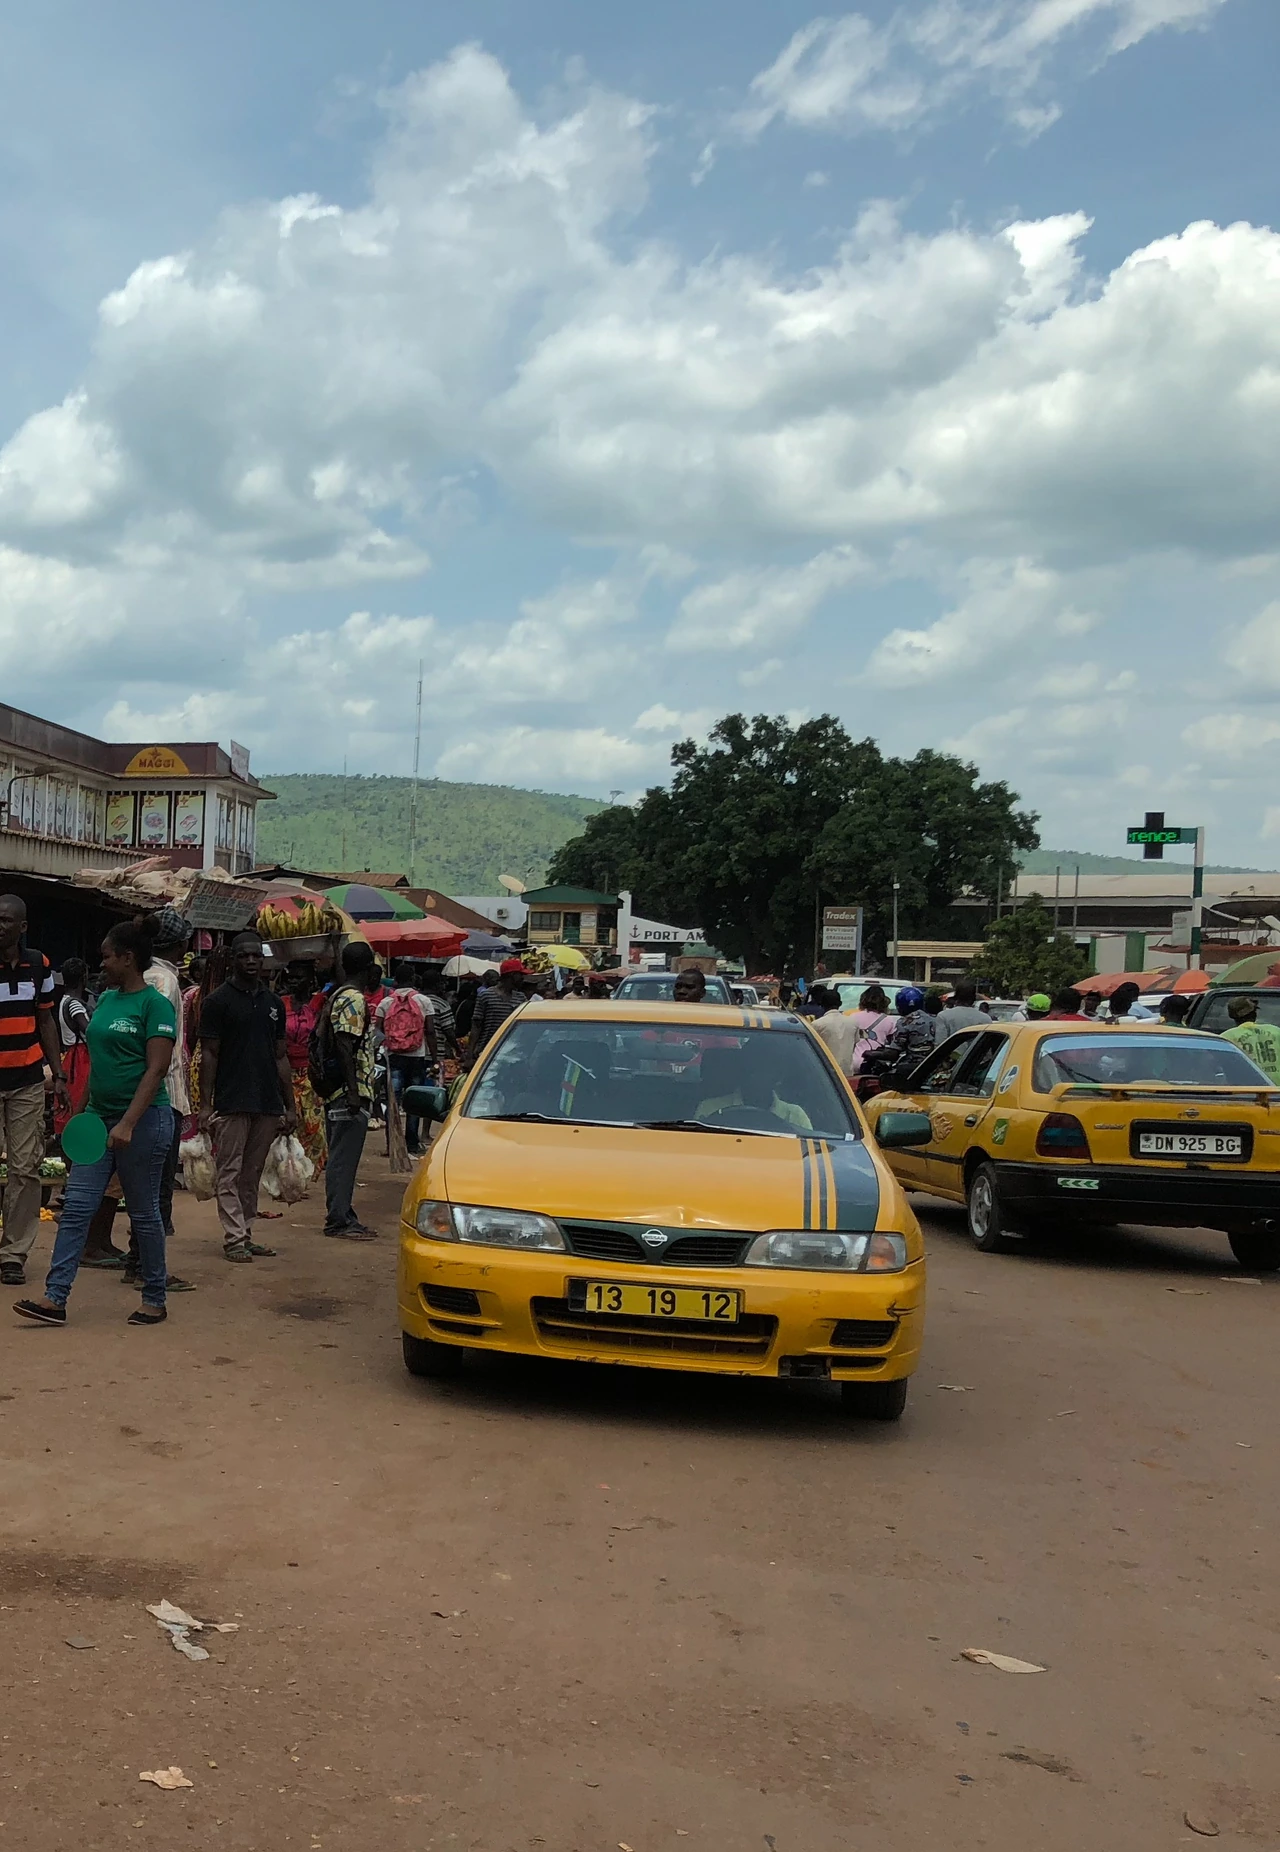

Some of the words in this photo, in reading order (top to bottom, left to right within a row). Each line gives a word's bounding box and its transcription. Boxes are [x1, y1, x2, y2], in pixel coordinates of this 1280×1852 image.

[138, 758, 175, 768] MAGGI
[826, 911, 856, 920] Tradex
[644, 930, 680, 941] PORT
[686, 930, 706, 941] AM
[1155, 1136, 1174, 1150] DN
[1178, 1137, 1207, 1151] 925
[1214, 1138, 1236, 1152] BG
[593, 1285, 623, 1312] 13
[647, 1289, 676, 1316] 19
[701, 1292, 731, 1319] 12
